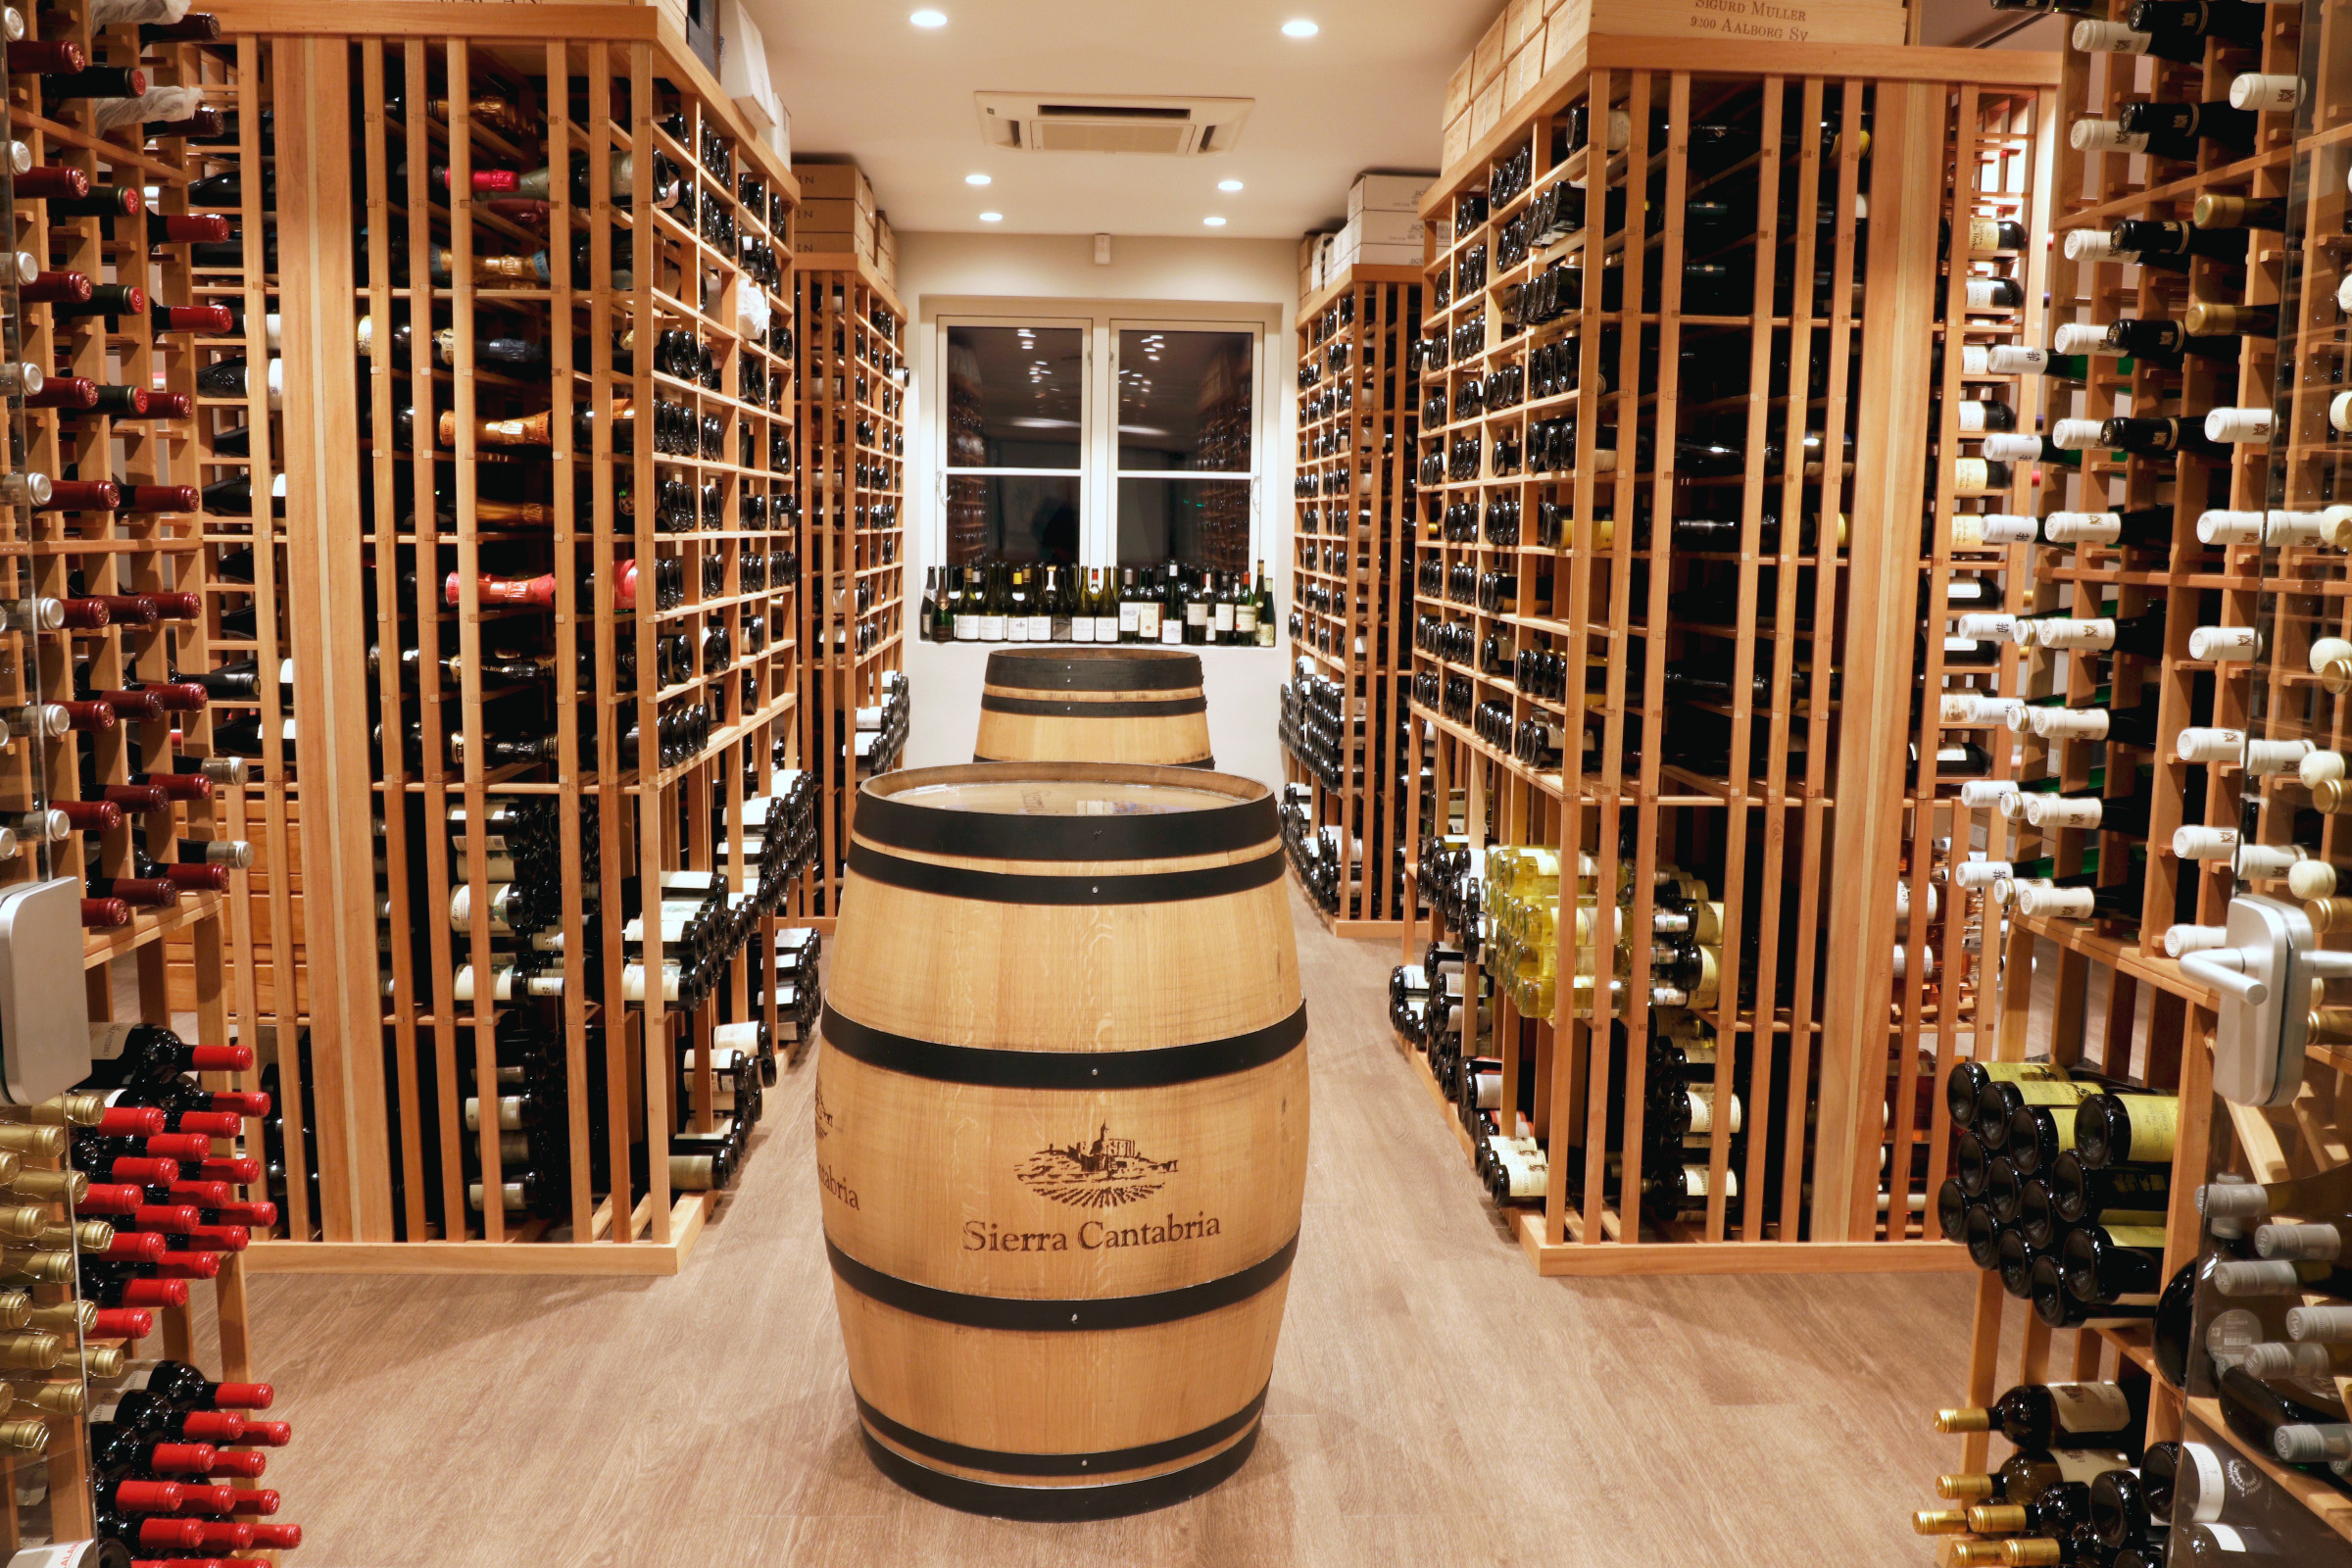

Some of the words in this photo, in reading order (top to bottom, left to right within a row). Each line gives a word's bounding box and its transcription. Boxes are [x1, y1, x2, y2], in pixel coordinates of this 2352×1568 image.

[1695, 0, 1744, 13] SIGURD
[1690, 16, 1716, 29] 9200
[1721, 18, 1783, 38] AALBORG
[817, 1162, 859, 1211] ntabria
[962, 1220, 1068, 1252] Sierra
[1077, 1211, 1222, 1250] Cantabria
